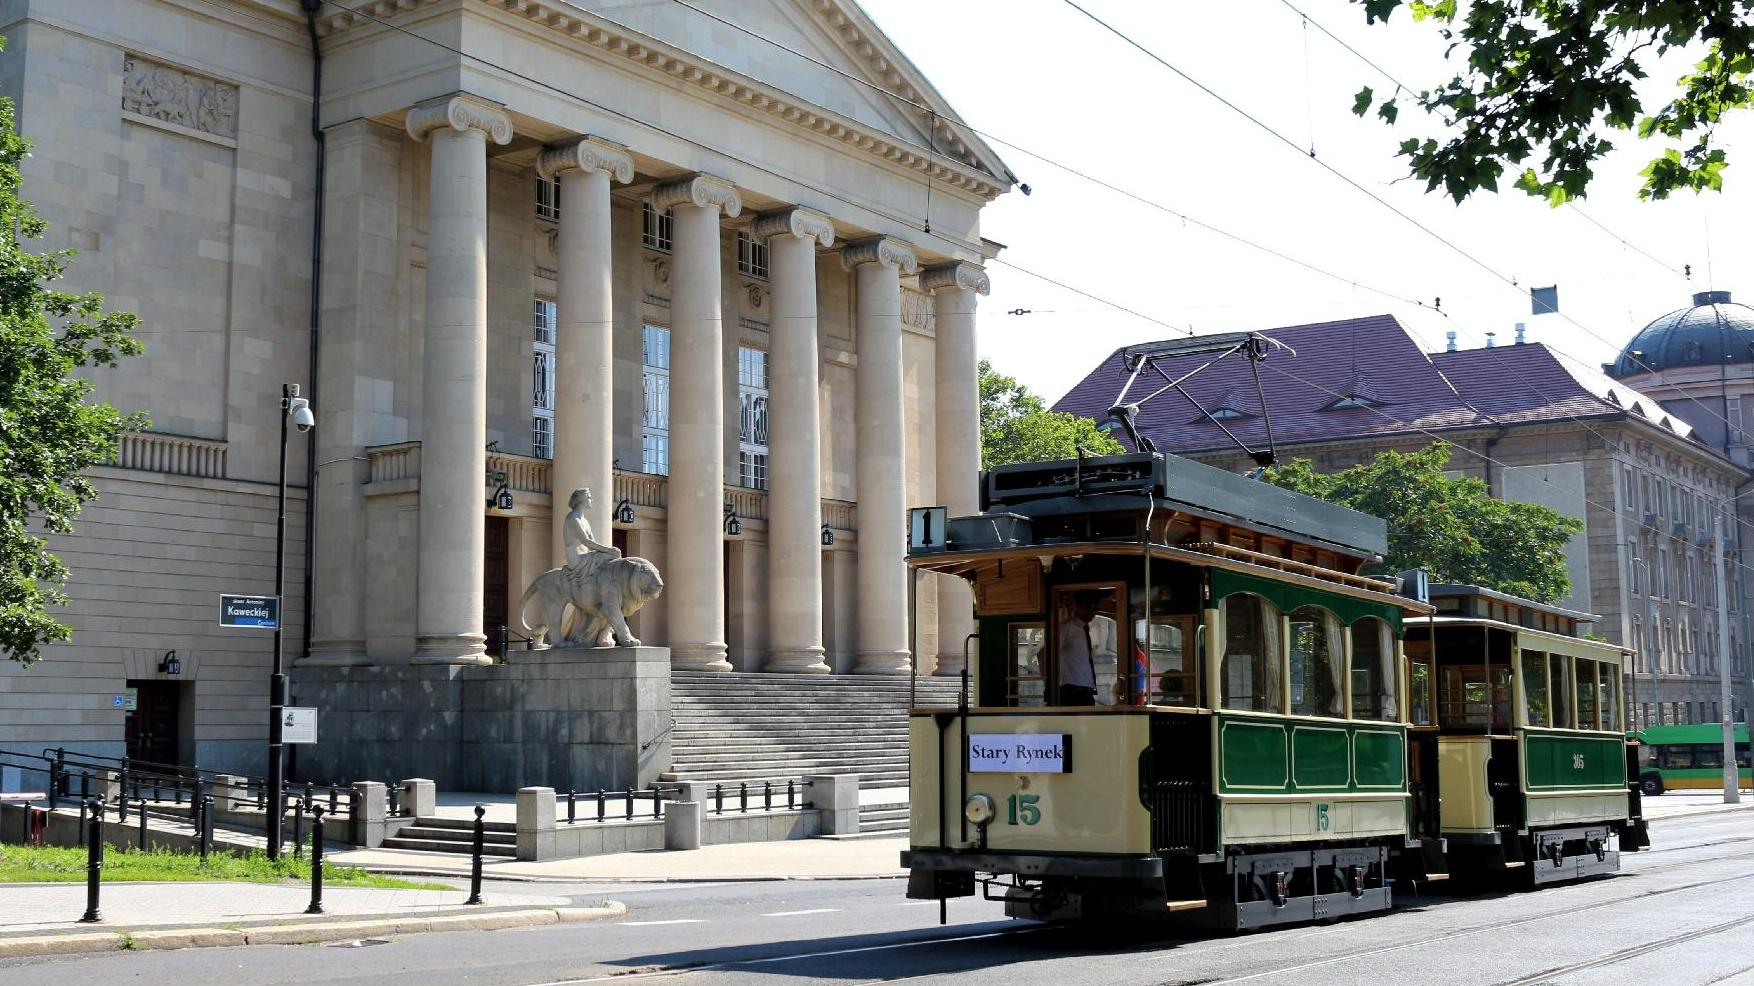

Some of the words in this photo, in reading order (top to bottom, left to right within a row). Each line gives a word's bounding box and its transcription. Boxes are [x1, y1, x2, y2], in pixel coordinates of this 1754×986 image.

[922, 510, 932, 545] 1
[228, 605, 269, 619] Kaweckiej
[972, 744, 1010, 765] Stary
[1016, 744, 1064, 765] Rynek
[1007, 794, 1042, 826] 15
[1316, 803, 1329, 832] 15
